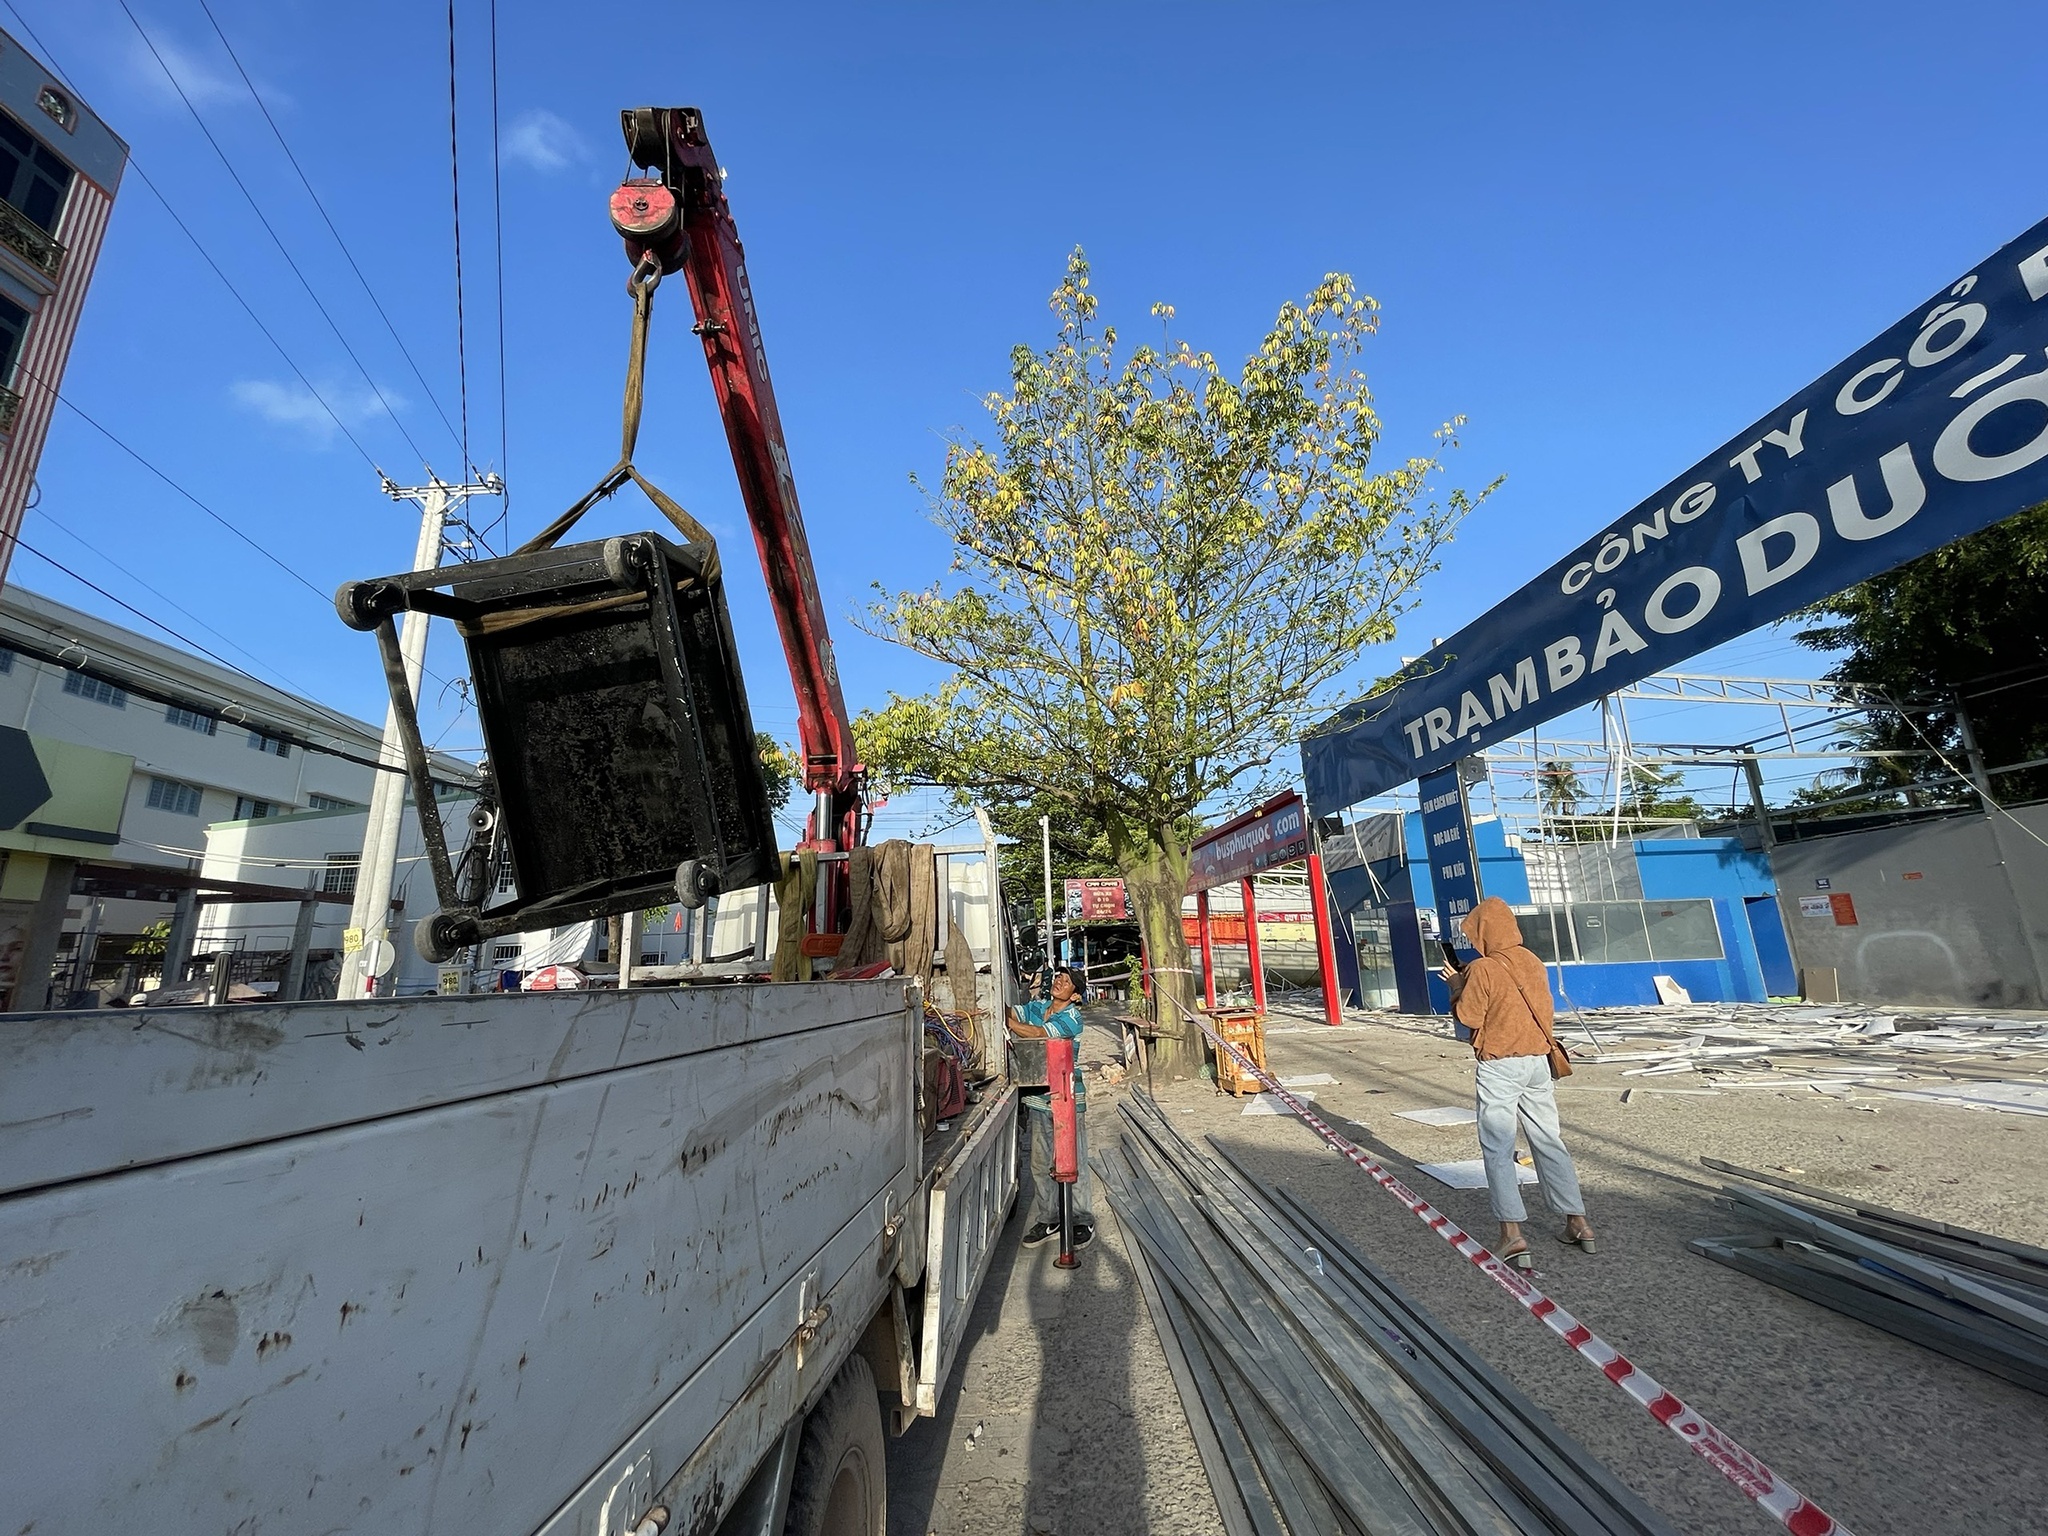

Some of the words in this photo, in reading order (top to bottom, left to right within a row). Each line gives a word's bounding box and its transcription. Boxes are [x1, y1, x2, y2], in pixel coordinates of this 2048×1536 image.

[1561, 482, 1717, 595] CÔNG
[1729, 408, 1808, 484] TY
[1835, 275, 1988, 416] CỔ
[1404, 656, 1540, 758] TRẠM
[1544, 566, 1722, 693] BẢO
[1216, 823, 1271, 860] busphuquoc
[345, 934, 359, 943] 980
